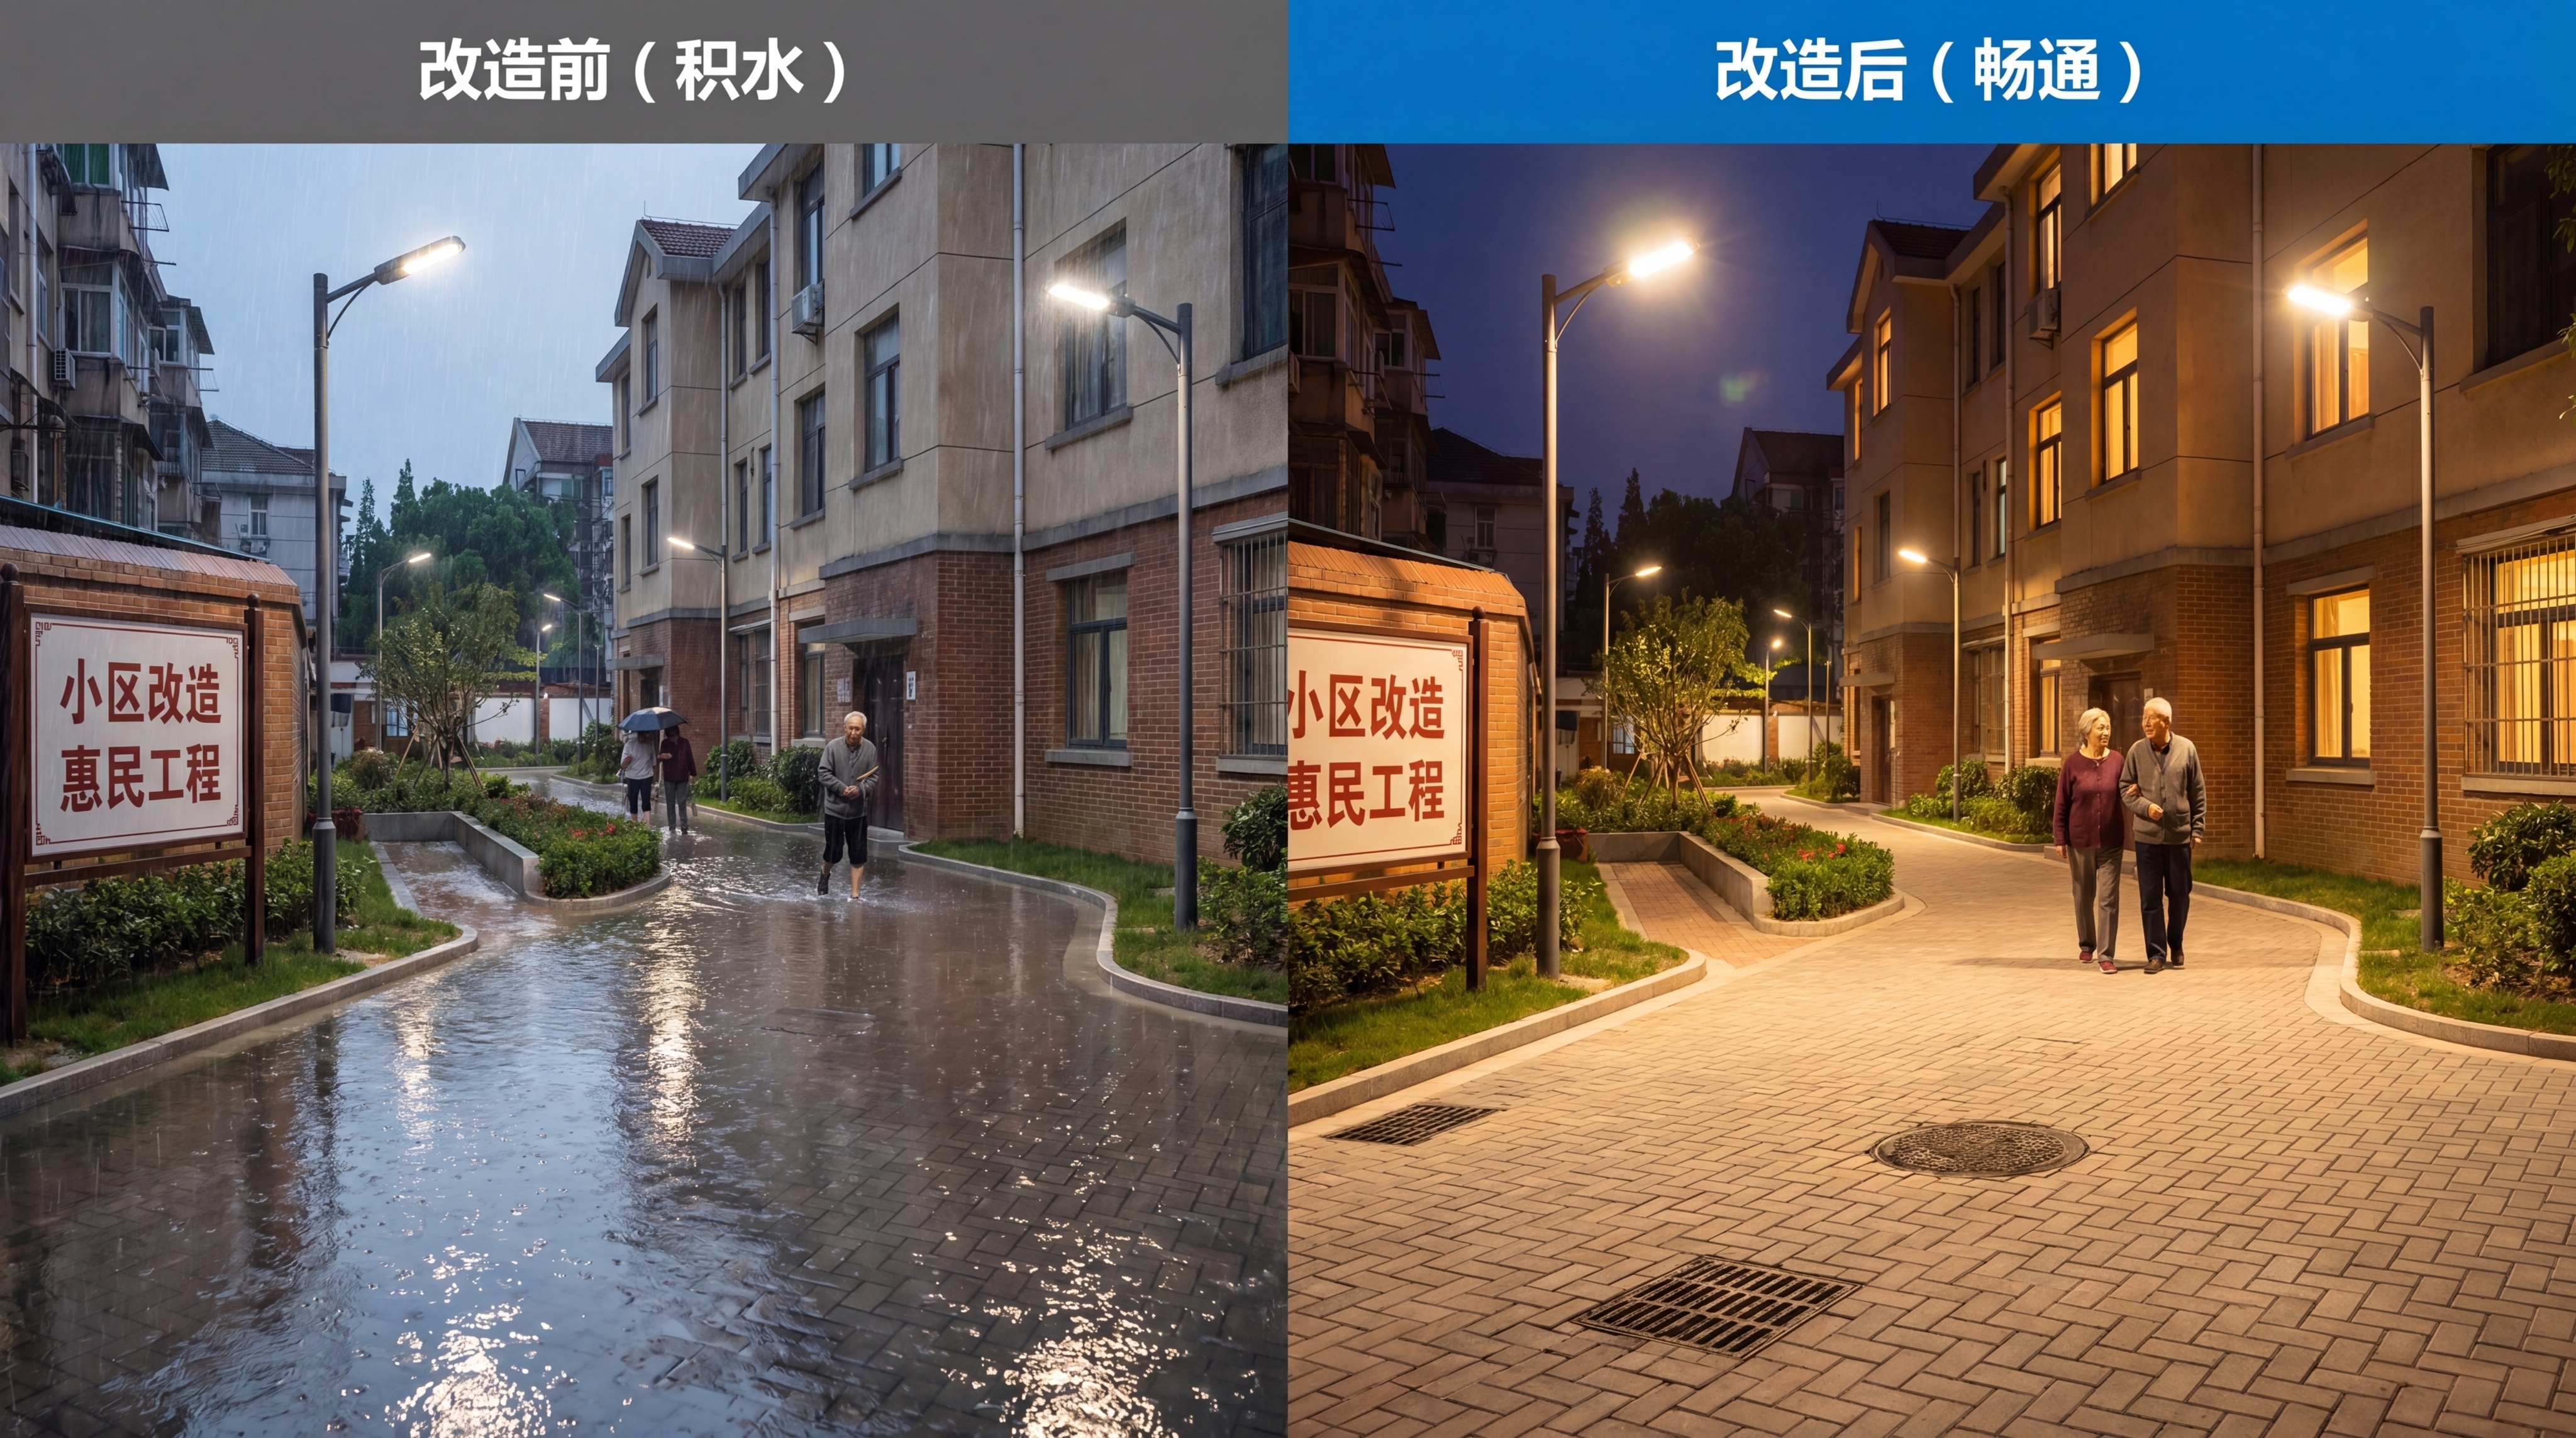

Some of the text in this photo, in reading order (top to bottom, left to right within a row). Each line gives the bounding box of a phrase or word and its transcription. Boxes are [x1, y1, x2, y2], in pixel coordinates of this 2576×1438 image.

[60, 657, 221, 724] 小区改造
[1288, 670, 1445, 740] 小区改造
[60, 743, 221, 813] 惠民工程
[1288, 759, 1445, 831] 惠民工程
